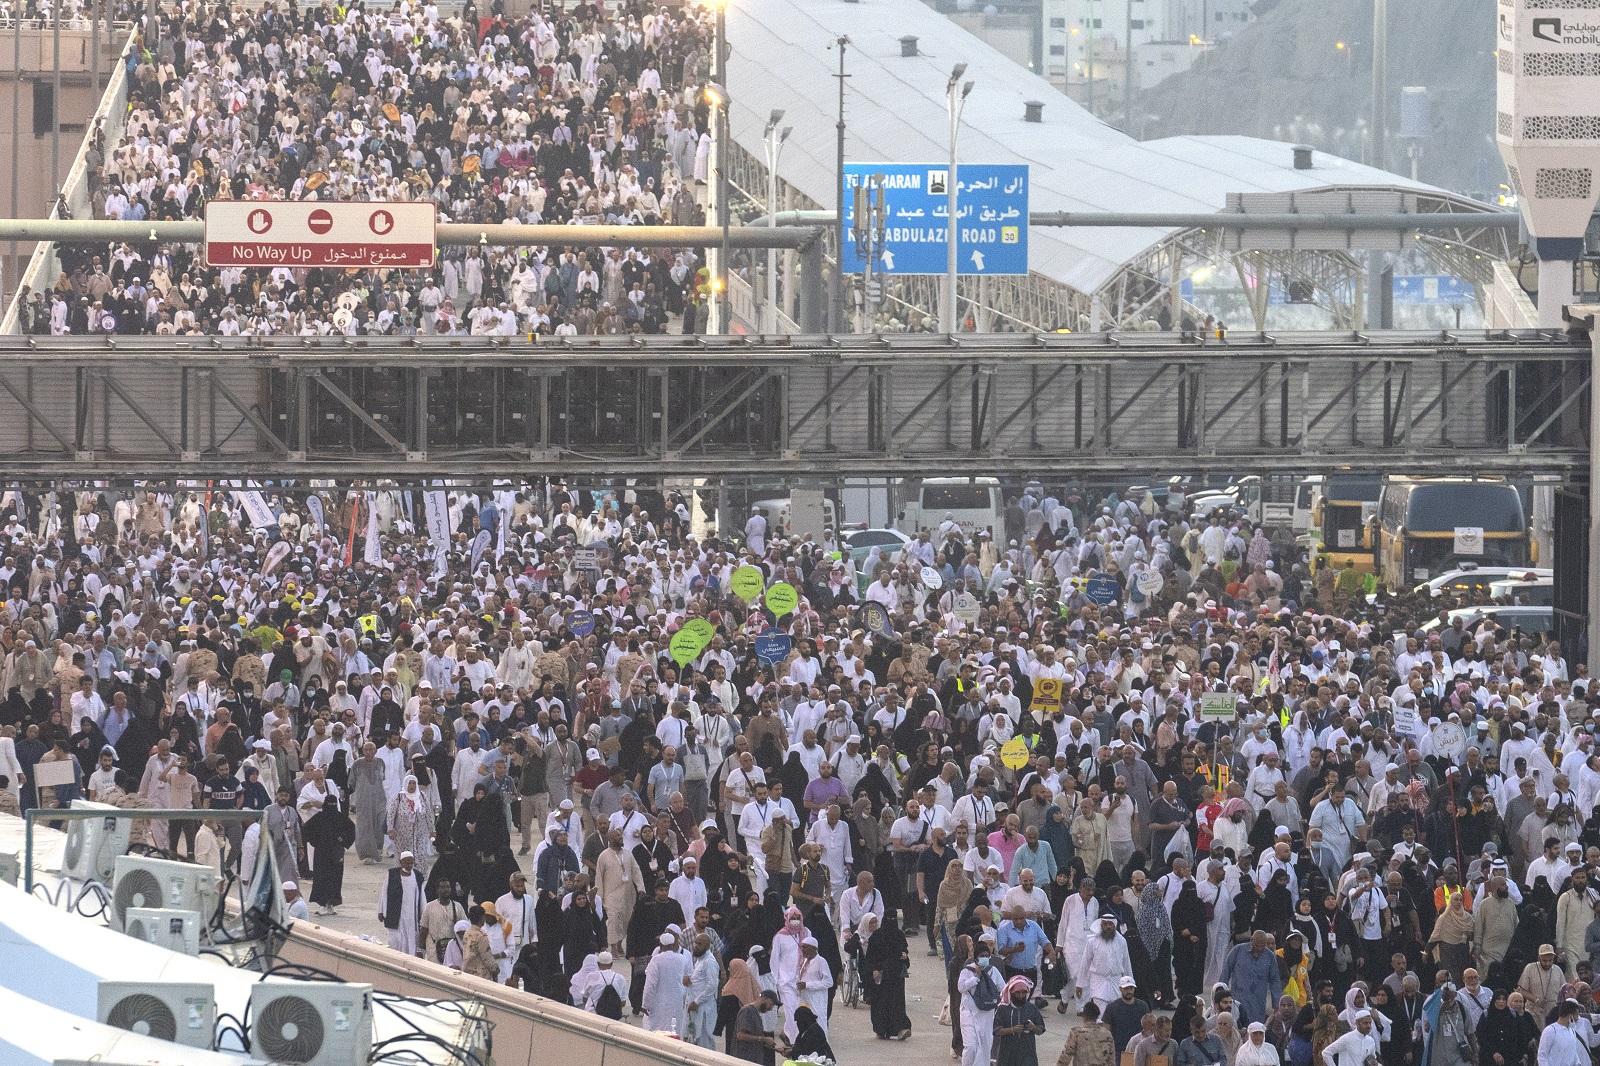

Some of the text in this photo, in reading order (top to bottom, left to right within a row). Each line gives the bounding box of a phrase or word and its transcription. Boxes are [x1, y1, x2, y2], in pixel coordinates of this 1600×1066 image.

[955, 177, 1023, 195] إلى الحرم
[896, 207, 926, 221] عبد
[932, 205, 973, 219] المك
[979, 205, 1020, 222] طريق
[885, 228, 952, 243] ABDULAZI
[962, 228, 996, 243] ROAD
[232, 245, 312, 262] No Way Up
[324, 247, 407, 265] ممنوع الدخول
